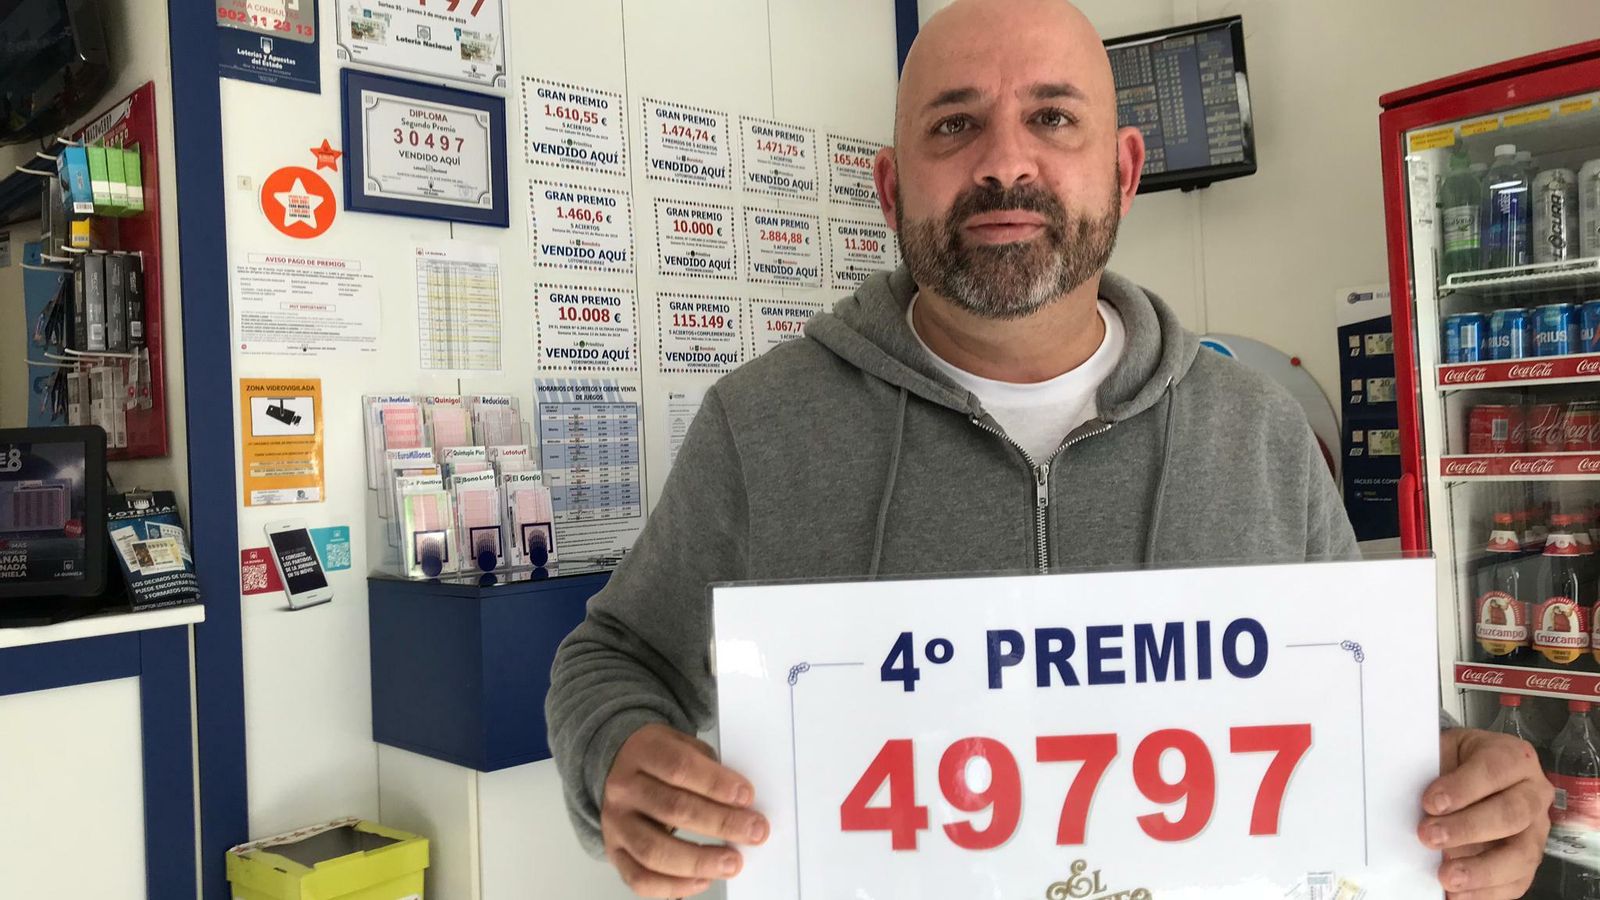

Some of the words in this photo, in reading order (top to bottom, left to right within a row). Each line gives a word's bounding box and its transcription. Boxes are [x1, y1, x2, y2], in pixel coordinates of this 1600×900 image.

[218, 7, 246, 23] 902
[251, 15, 267, 28] 11
[273, 19, 291, 33] 23
[296, 24, 313, 37] 13
[423, 40, 453, 52] Nacional
[251, 57, 262, 66] del
[262, 59, 283, 70] Estado
[269, 55, 296, 66] Apuestas
[537, 88, 566, 102] GRAN
[569, 93, 608, 110] PREMIO
[409, 109, 448, 123] DIPLOMA
[544, 103, 599, 126] 1.610,55
[601, 117, 608, 127] €
[655, 108, 680, 122] GRAN
[683, 113, 716, 128] PREMIO
[401, 117, 431, 130] Segundo
[432, 122, 456, 133] Premio
[661, 123, 709, 143] 1.474,74
[711, 135, 716, 144] €
[751, 125, 773, 137] GRAN
[775, 130, 805, 144] PREMIO
[398, 150, 438, 163] VENDIDO
[532, 142, 587, 159] VENDIDO
[590, 151, 619, 166] AQUÍ
[757, 139, 799, 157] 1.471,75
[800, 150, 806, 158] €
[837, 143, 857, 154] GRAN
[652, 158, 699, 175] VENDIDO
[701, 166, 725, 180] AQUÍ
[748, 172, 790, 187] VENDIDO
[792, 179, 814, 193] AQUÍ
[545, 190, 575, 203] GRAN
[577, 194, 617, 208] PREMIO
[834, 185, 870, 199] VENDIDO
[556, 206, 604, 225] 1.460,6
[606, 214, 612, 224] €
[666, 207, 690, 218] GRAN
[691, 210, 723, 222] PREMIO
[574, 223, 600, 232] ACIERTOS
[673, 219, 715, 236] 10.000
[716, 227, 723, 237] €
[755, 215, 779, 227] GRAN
[780, 218, 810, 231] PREMIO
[760, 229, 803, 245] 2.884,88
[804, 237, 810, 246] €
[838, 226, 858, 236] GRAN
[859, 228, 887, 241] PREMIO
[845, 237, 879, 253] 11.300
[881, 244, 887, 254] €
[265, 256, 286, 264] AVISO
[287, 257, 306, 265] PAGO
[317, 259, 346, 269] PREMIOS
[541, 244, 596, 259] VENDIDO
[598, 249, 627, 265] AQUÍ
[664, 255, 707, 268] VENDIDO
[709, 258, 731, 272] AQUÍ
[753, 263, 794, 276] VENDIDO
[796, 266, 818, 280] AQUÍ
[549, 293, 579, 304] GRAN
[581, 295, 621, 307] PREMIO
[669, 301, 694, 312] GRAN
[696, 303, 730, 314] PREMIO
[558, 306, 611, 323] 10.008
[614, 312, 622, 324] €
[761, 307, 783, 317] GRAN
[672, 313, 725, 330] 115.149
[727, 319, 734, 330] €
[546, 347, 599, 360] VENDIDO
[601, 346, 630, 363] AQUÍ
[665, 352, 712, 363] VENDIDO
[713, 350, 739, 365] AQUÍ
[1444, 367, 1487, 384] Coca-Cola
[1507, 363, 1555, 380] Coca-Cola
[246, 384, 265, 393] ZONA
[266, 384, 316, 393] VIDEOVIGILADA
[538, 385, 567, 393] HORARIOS
[434, 397, 462, 406] Quinigol
[482, 396, 510, 407] Reducidas
[1445, 460, 1490, 475] Coca-Cola
[1509, 459, 1556, 475] Coca-Cola
[512, 475, 520, 483] El
[520, 474, 542, 483] Gordo
[292, 556, 313, 565] PARTIDOS
[298, 560, 319, 570] JORNADA
[135, 586, 154, 595] PUEDE
[155, 580, 188, 591] ENCONTRAR
[149, 587, 182, 599] FORMATOS
[1477, 625, 1524, 639] Cruzcampo
[1537, 632, 1588, 646] Cruzcampo
[880, 631, 954, 693] 4º
[986, 617, 1269, 690] PREMIO
[1461, 668, 1505, 685] Coca-Cola
[1526, 673, 1573, 691] Coca-Cola
[840, 722, 1314, 851] 49797
